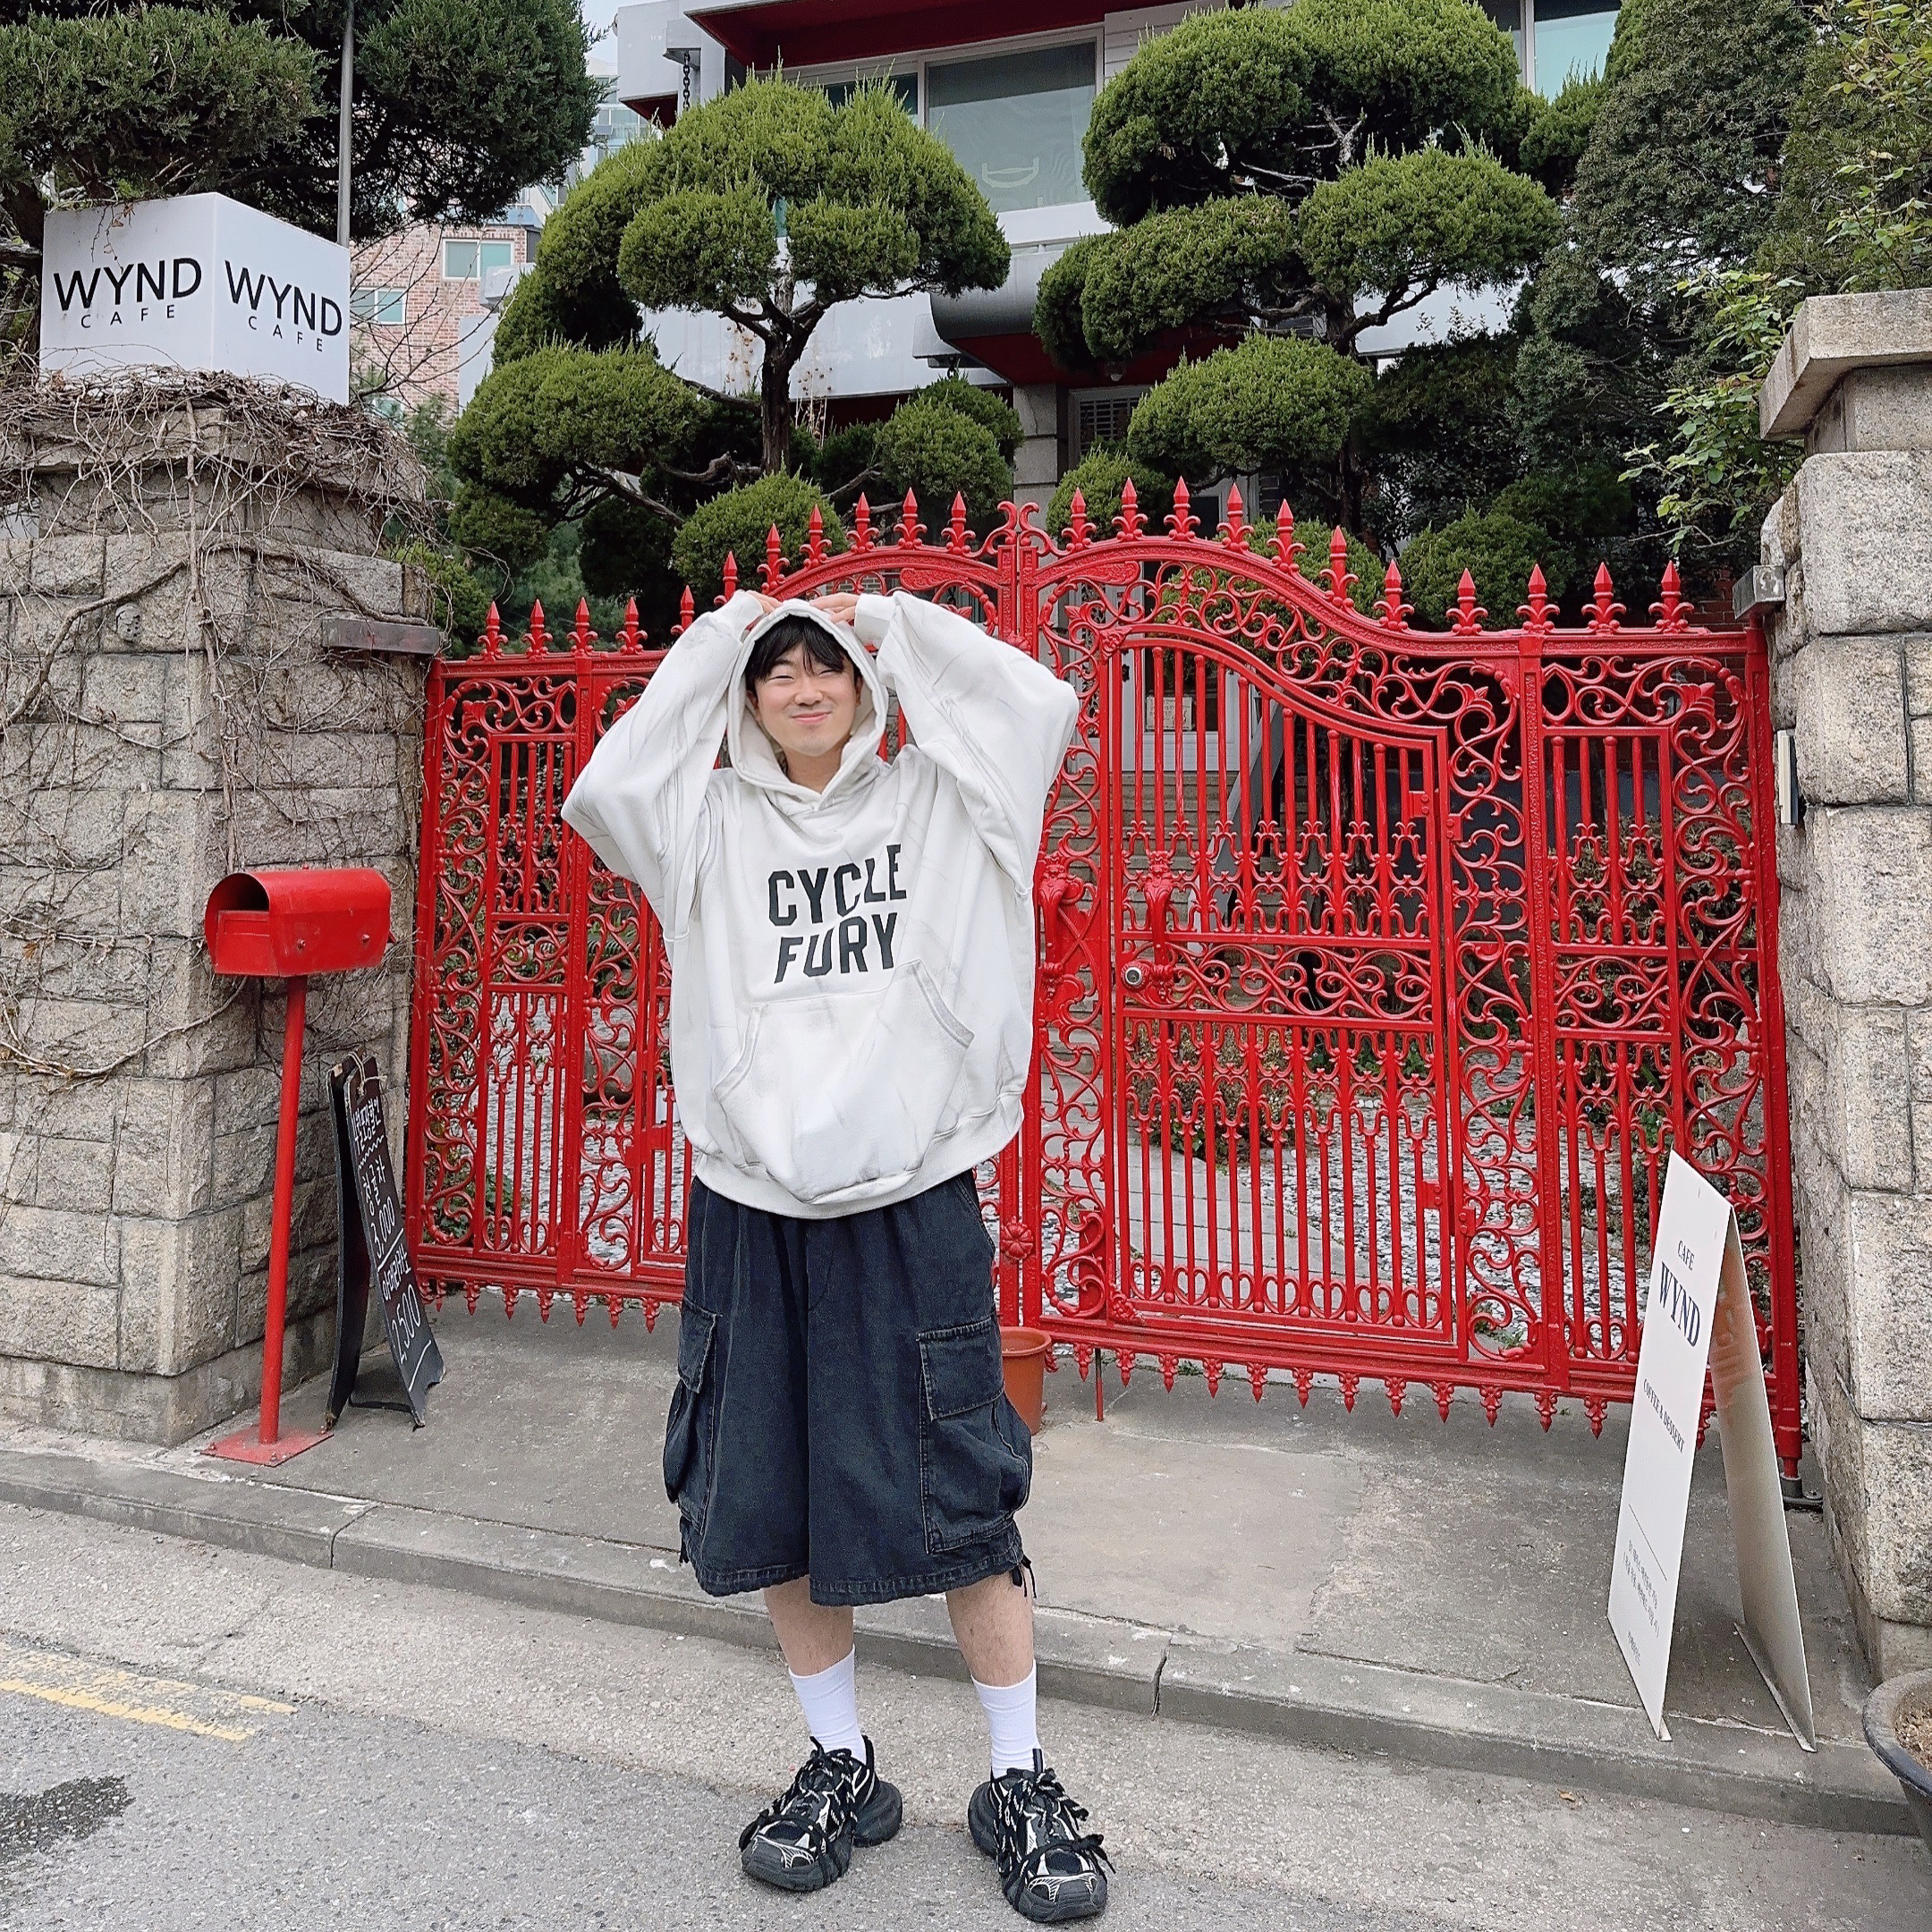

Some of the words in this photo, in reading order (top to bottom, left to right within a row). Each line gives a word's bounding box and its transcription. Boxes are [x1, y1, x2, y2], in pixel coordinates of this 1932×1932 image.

[53, 258, 202, 311] WYND
[225, 259, 343, 336] WYND
[80, 304, 175, 329] CAFE
[248, 316, 323, 352] CAFE
[767, 843, 907, 927] CYCLE
[774, 912, 898, 985] FURY
[361, 1155, 386, 1216] 청귤차
[370, 1196, 395, 1259] 3,000
[1677, 1240, 1695, 1271] CAFE
[1659, 1260, 1701, 1348] WYND
[1643, 1378, 1659, 1413] COFFEE
[1663, 1411, 1685, 1454] DESSERT
